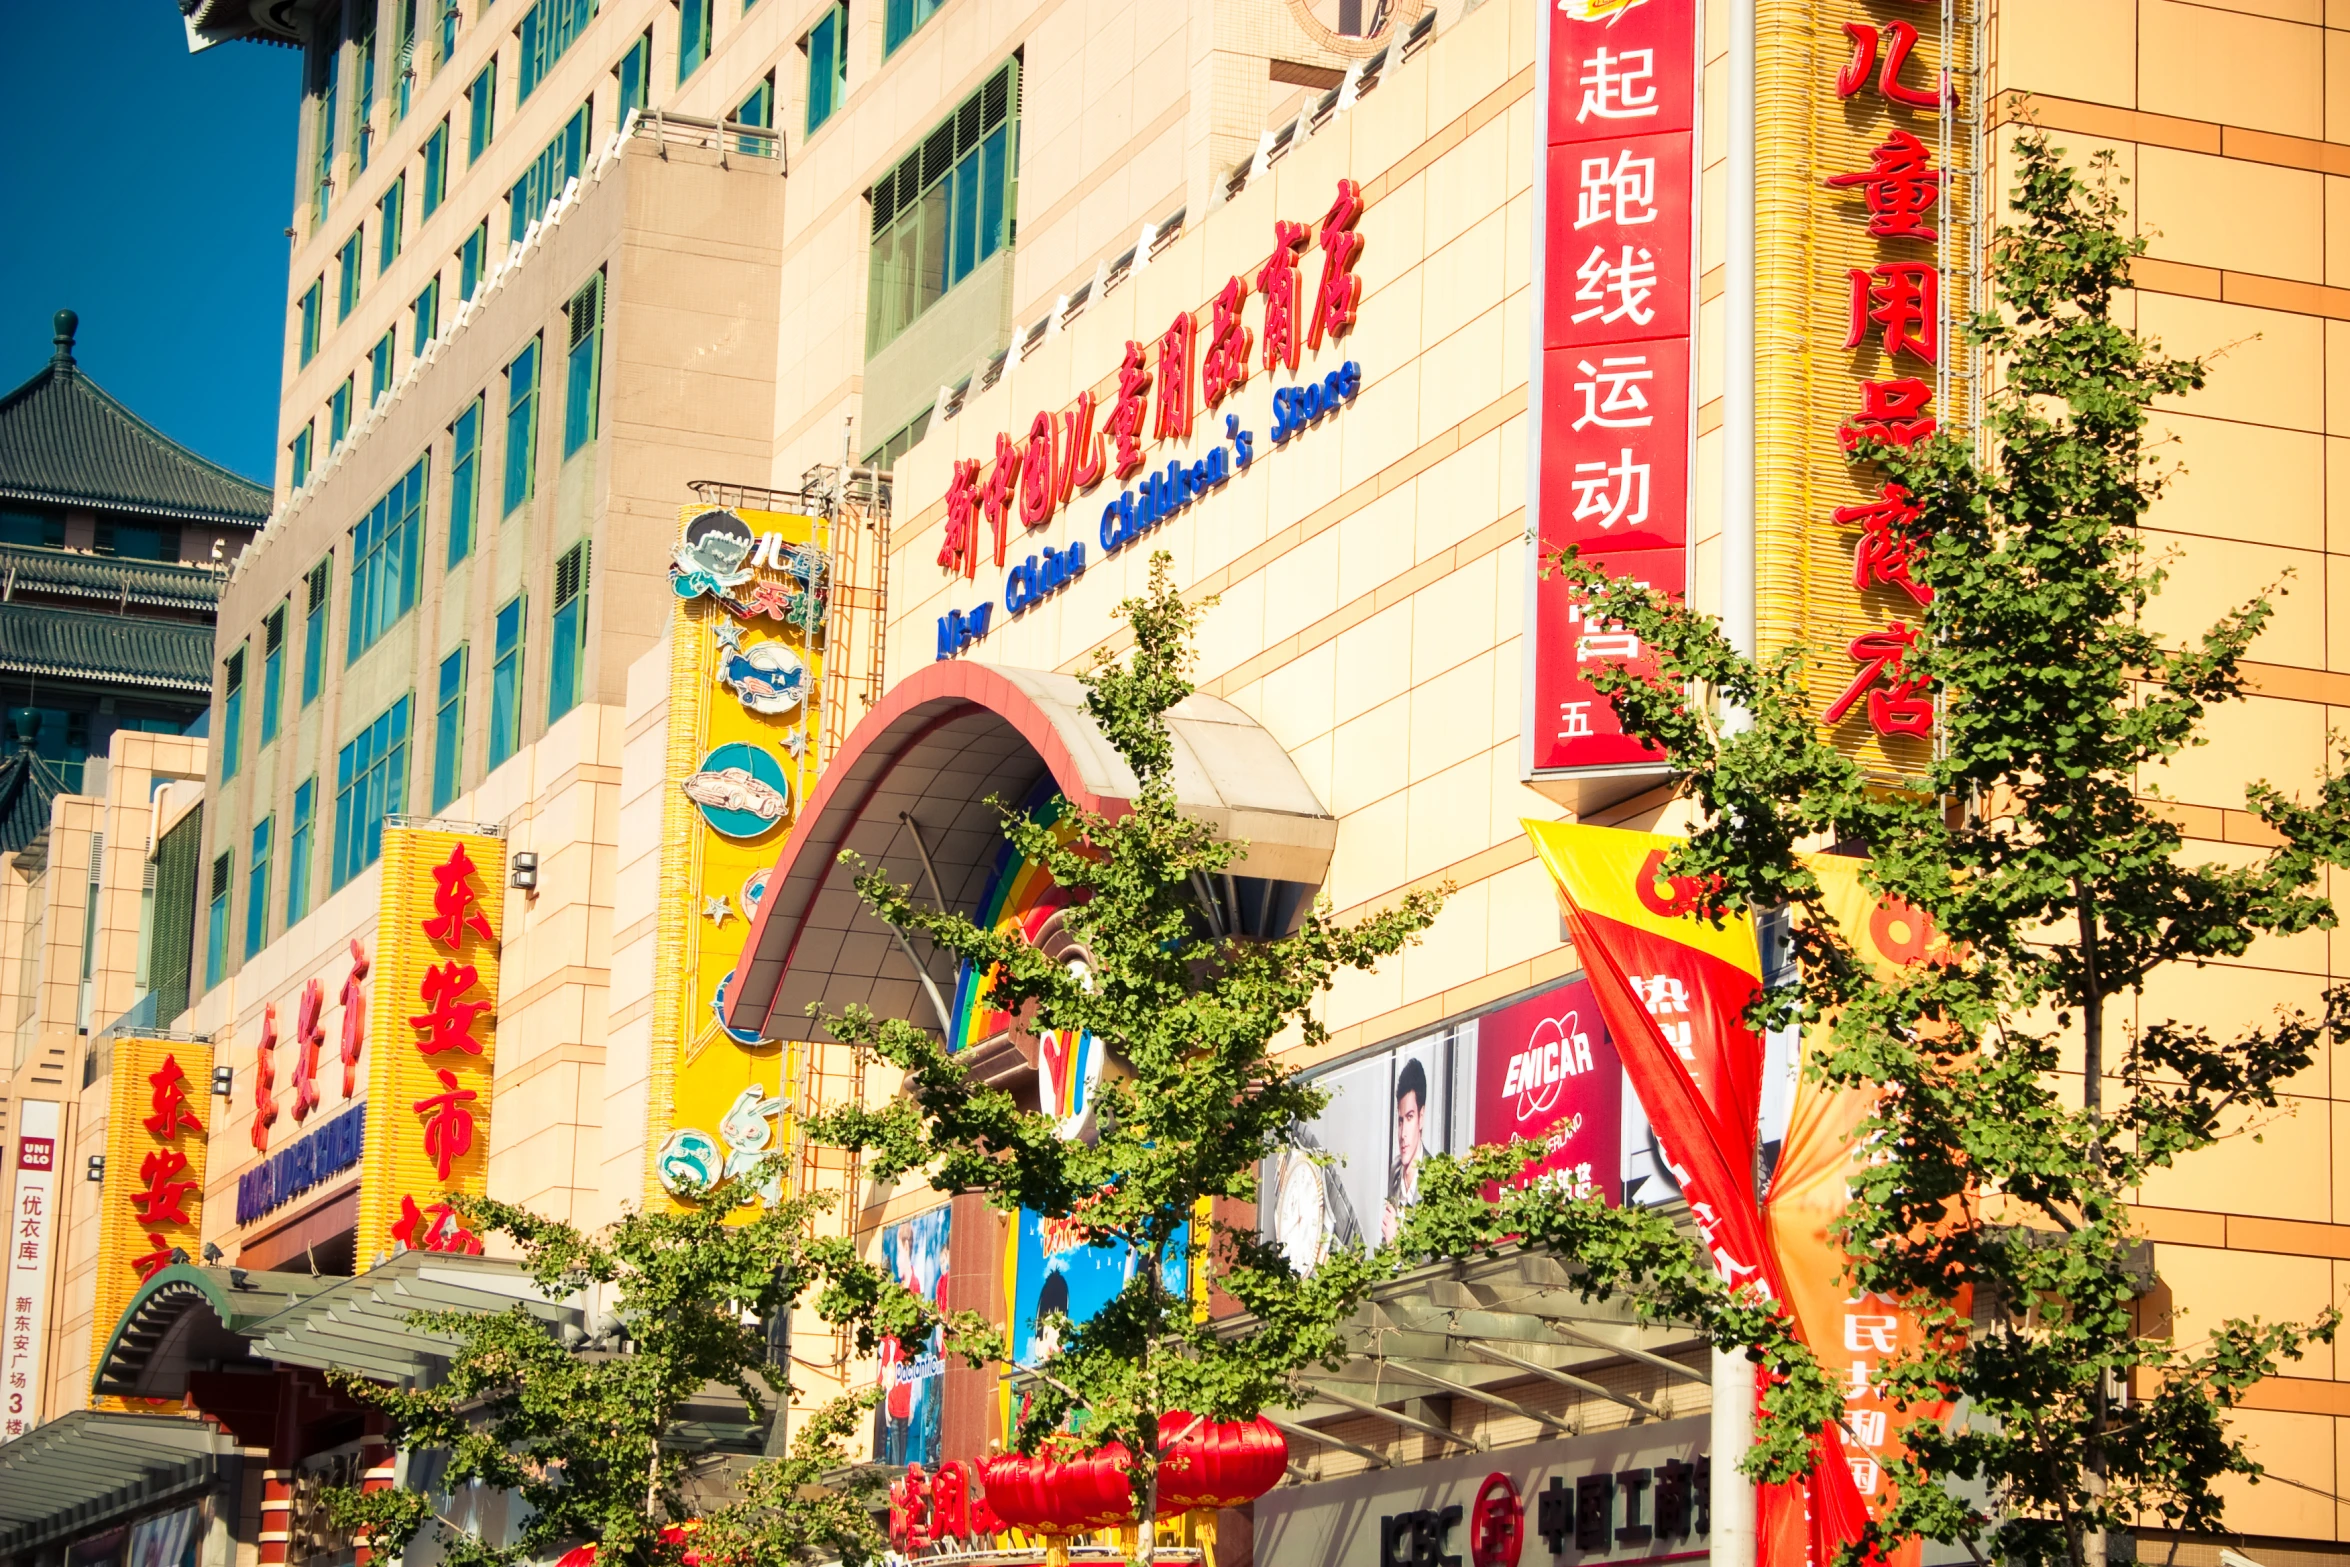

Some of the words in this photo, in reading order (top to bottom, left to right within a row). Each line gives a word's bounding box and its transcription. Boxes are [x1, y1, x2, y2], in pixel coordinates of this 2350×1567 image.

[937, 179, 1365, 579] 新中国儿童用品商店
[936, 601, 994, 662] New
[1006, 541, 1087, 614] China
[1100, 413, 1254, 551] Children's
[1271, 360, 1362, 443] Store
[392, 841, 494, 1256] 东安市场
[1502, 1032, 1595, 1099] ENICAR
[23, 1154, 50, 1165] QLO
[25, 1143, 50, 1155] UNI
[1381, 1505, 1463, 1567] ICBC
